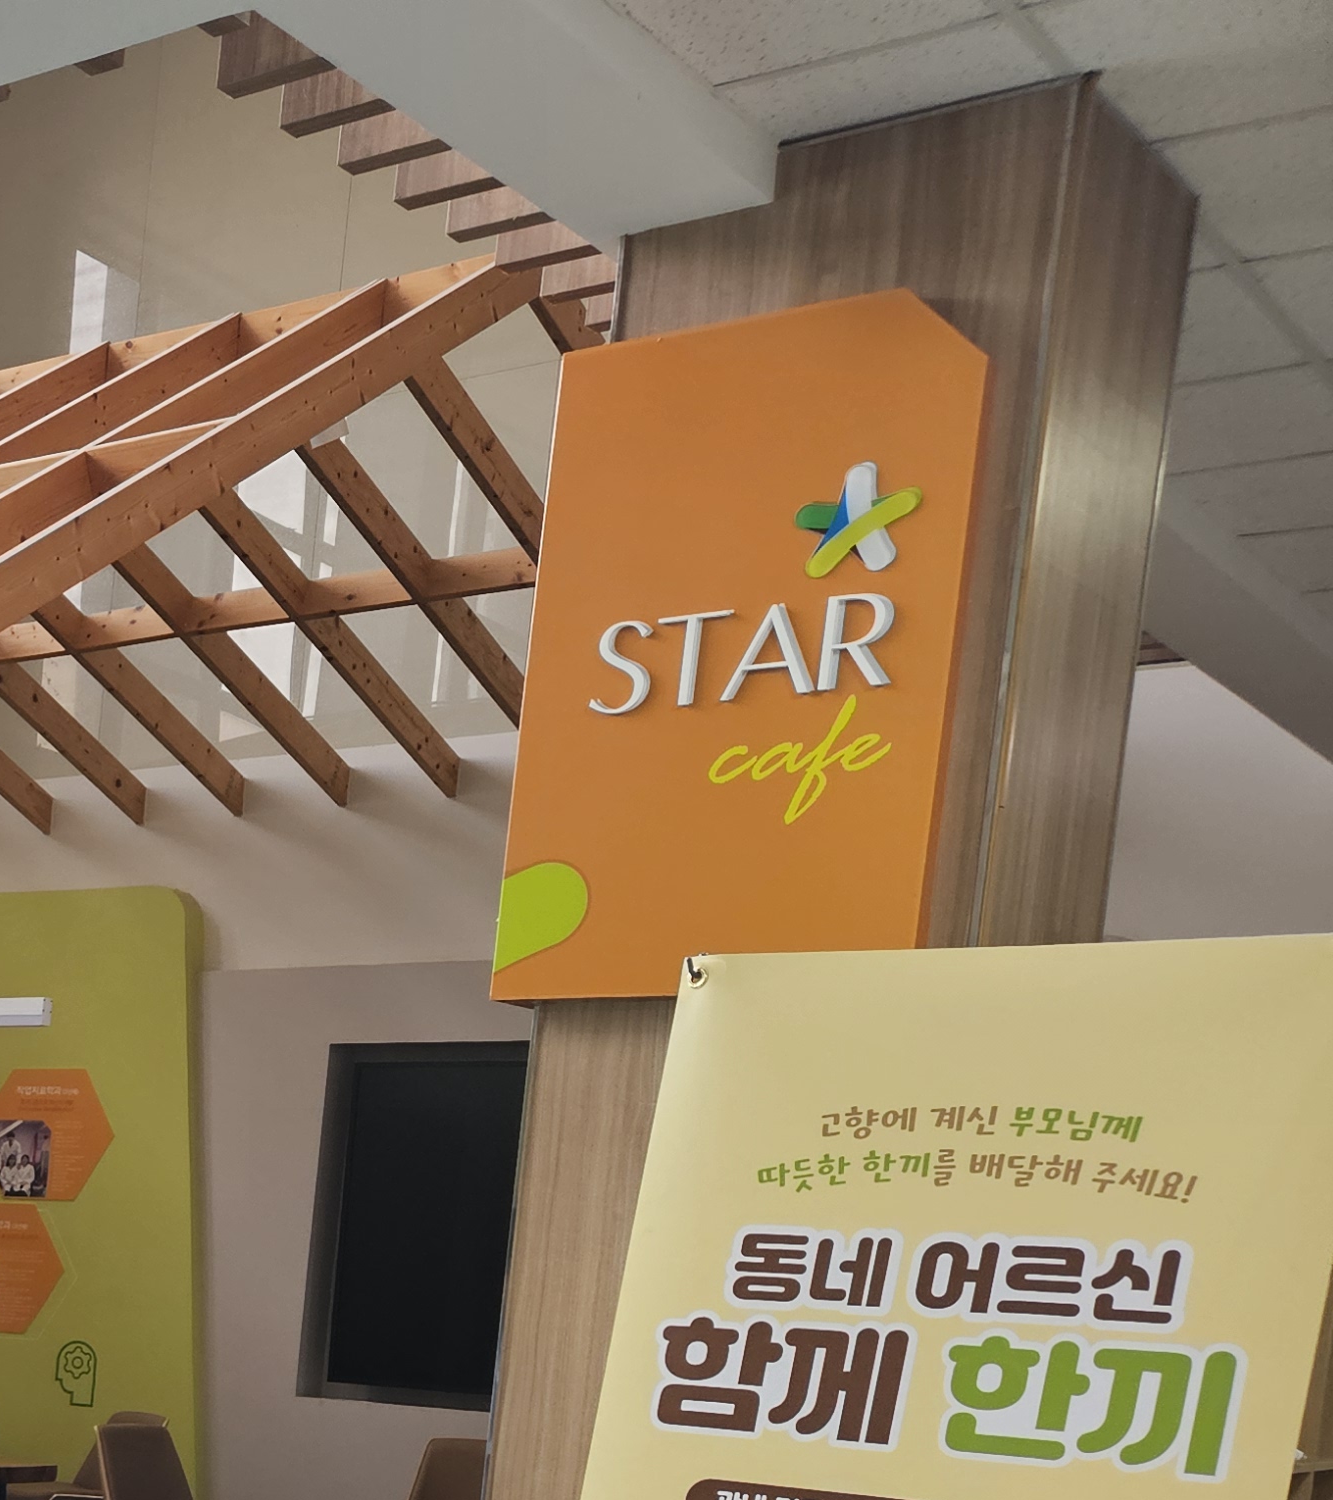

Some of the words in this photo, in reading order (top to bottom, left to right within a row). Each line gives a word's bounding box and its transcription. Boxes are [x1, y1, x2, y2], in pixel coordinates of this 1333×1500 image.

[589, 591, 897, 716] STAR
[709, 694, 891, 824] cafe
[757, 1153, 851, 1192] 따듯한
[862, 1151, 957, 1187] 한끼를
[969, 1152, 1080, 1188] 배달해
[1092, 1160, 1197, 1204] 주세요!
[820, 1105, 916, 1141] 고향에
[930, 1104, 998, 1136] 계신
[1008, 1104, 1143, 1144] 부모님께
[733, 1232, 894, 1309] 동네
[915, 1240, 1182, 1325] 어르신
[654, 1316, 910, 1447] 함께
[944, 1335, 1237, 1477] 한끼
